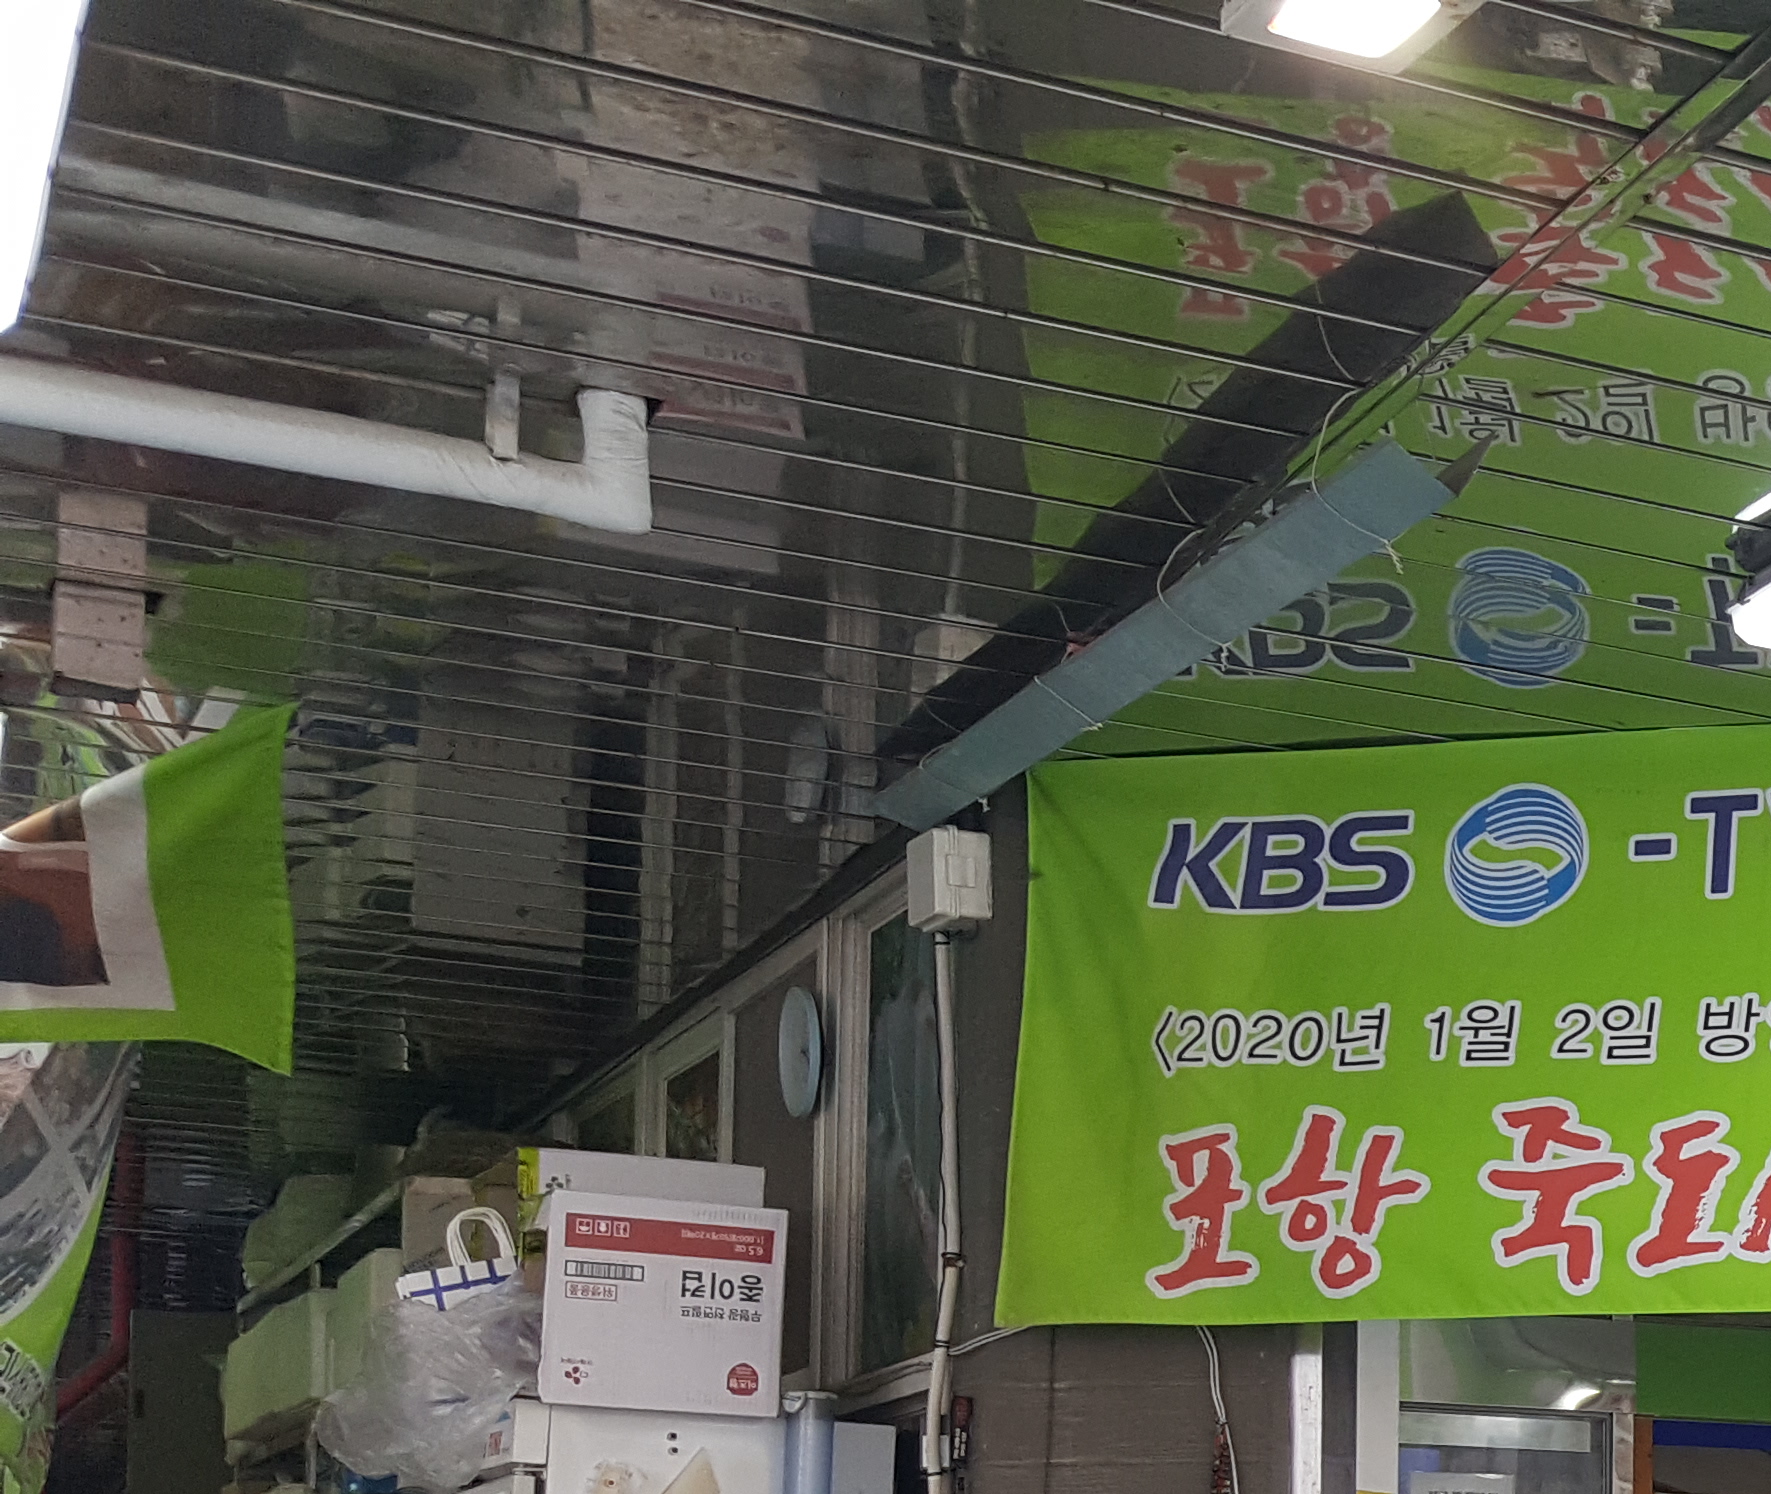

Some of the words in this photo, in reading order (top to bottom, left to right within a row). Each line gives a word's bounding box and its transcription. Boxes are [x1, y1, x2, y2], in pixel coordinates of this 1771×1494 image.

[1153, 815, 1412, 912] KBS
[1429, 1003, 1517, 1064] 1월
[1554, 999, 1659, 1064] 2일
[1151, 1109, 1427, 1297] 포항
[681, 1269, 764, 1303] 종이컵
